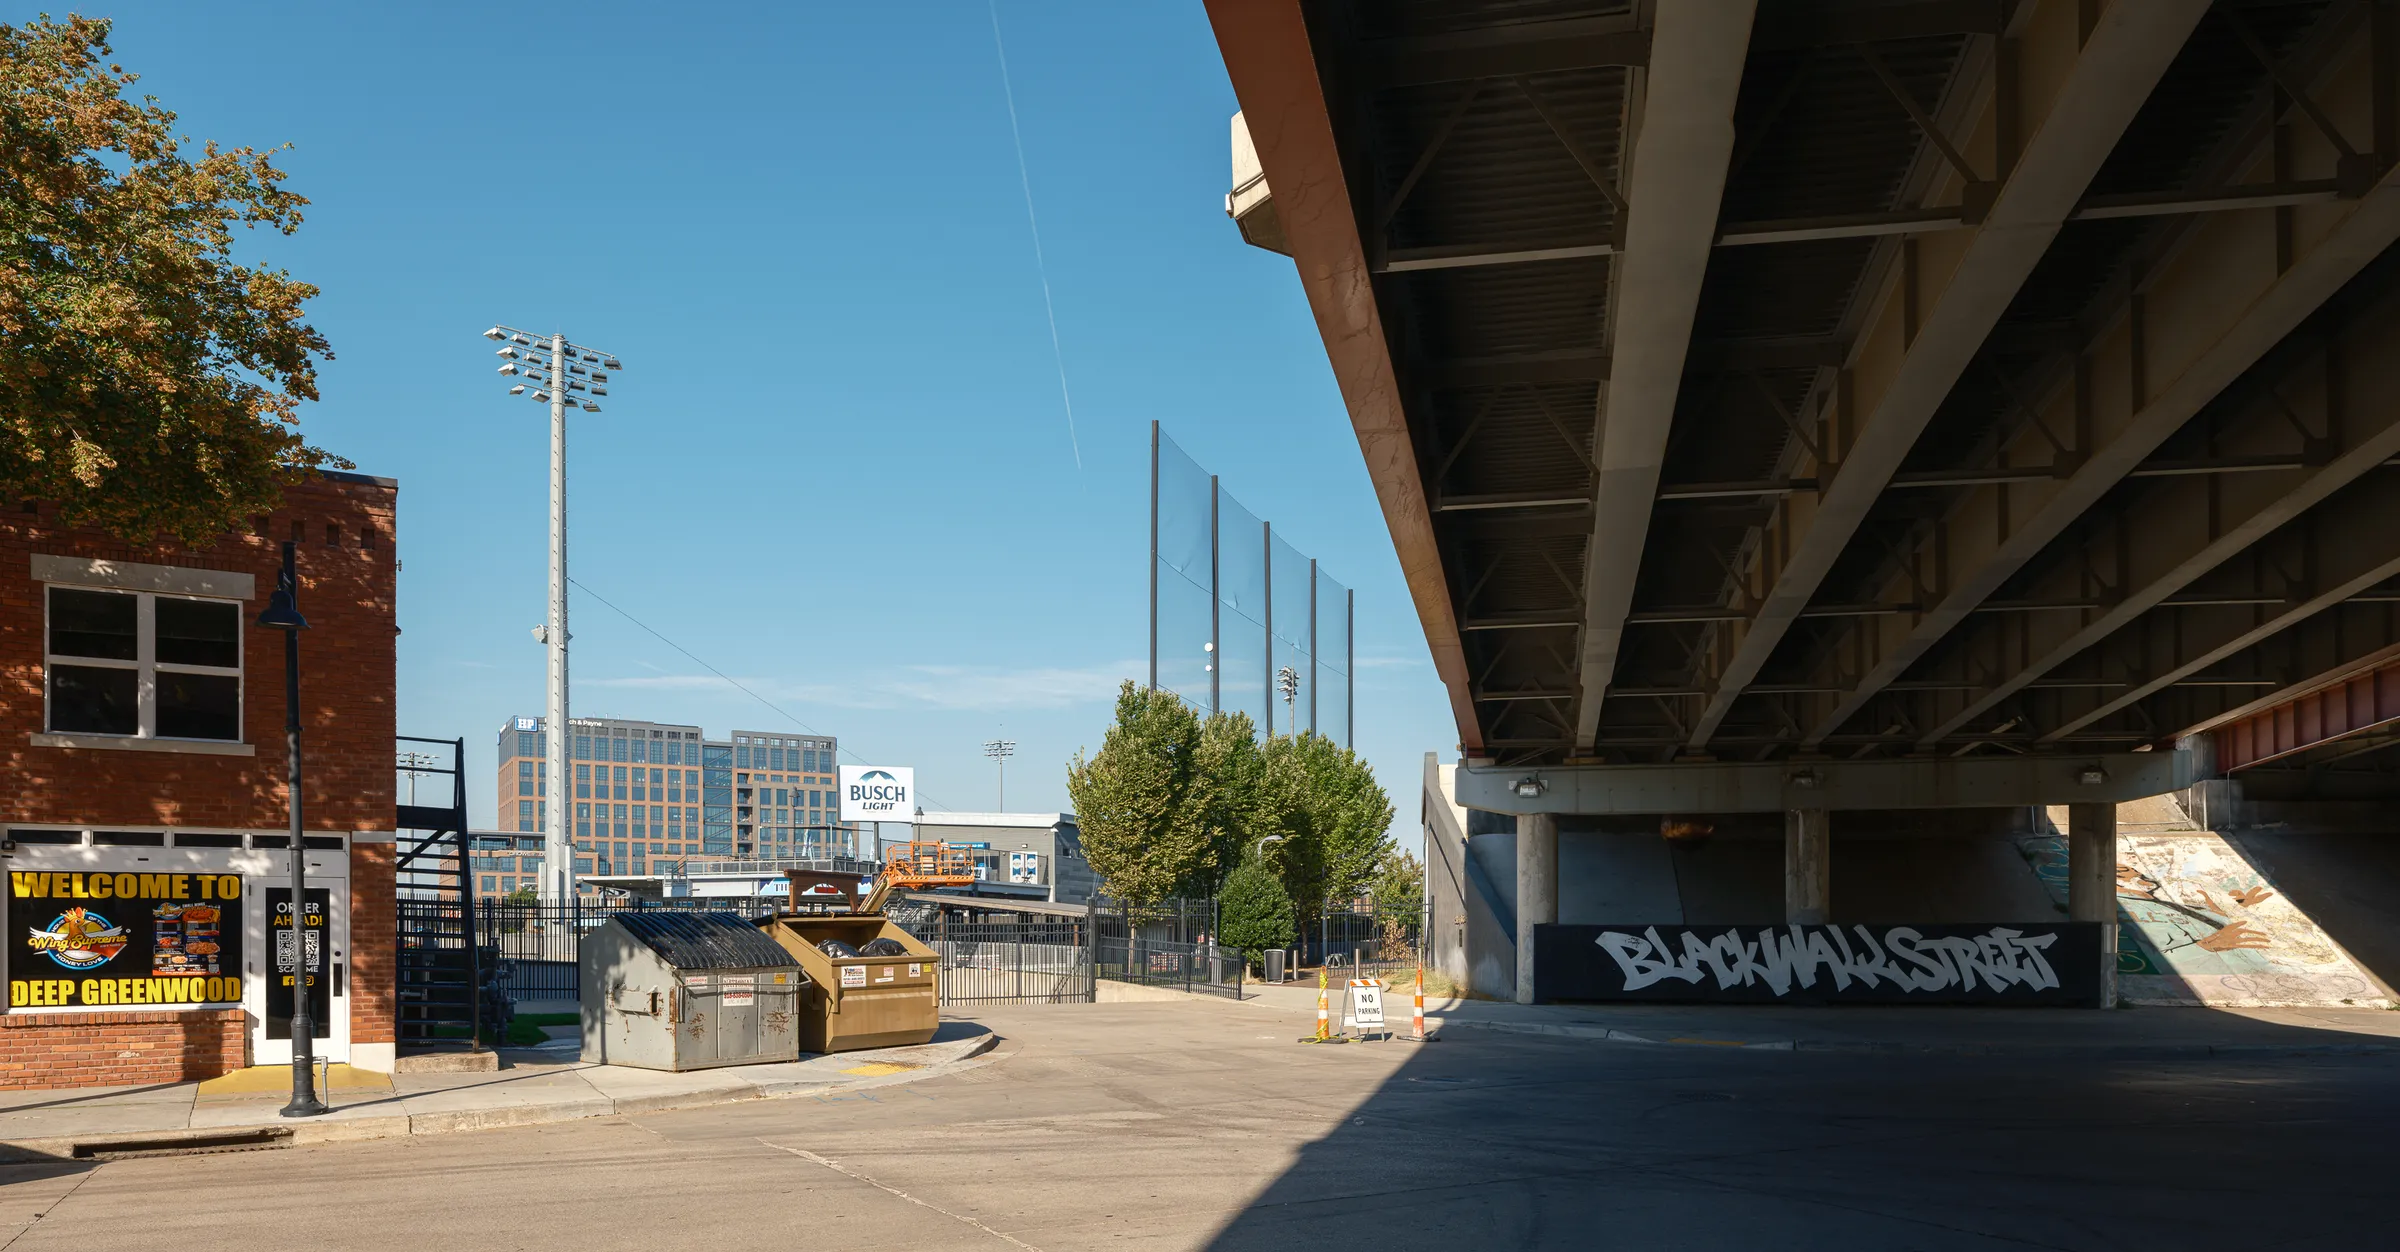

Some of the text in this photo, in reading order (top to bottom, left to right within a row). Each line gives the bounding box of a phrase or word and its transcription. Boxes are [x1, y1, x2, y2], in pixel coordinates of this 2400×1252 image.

[850, 785, 905, 802] BUSCH
[862, 802, 895, 810] LIGHT
[11, 873, 240, 899] WELCOME TO
[276, 902, 320, 913] ORER
[51, 919, 65, 932] HOME
[273, 915, 323, 926] AHAD!
[28, 935, 127, 952] Wing Supreme
[56, 953, 103, 967] HONEY LOVE
[278, 965, 295, 973] SCA
[10, 977, 240, 1006] DEEP GREENWOOD
[1361, 994, 1374, 1003] NO
